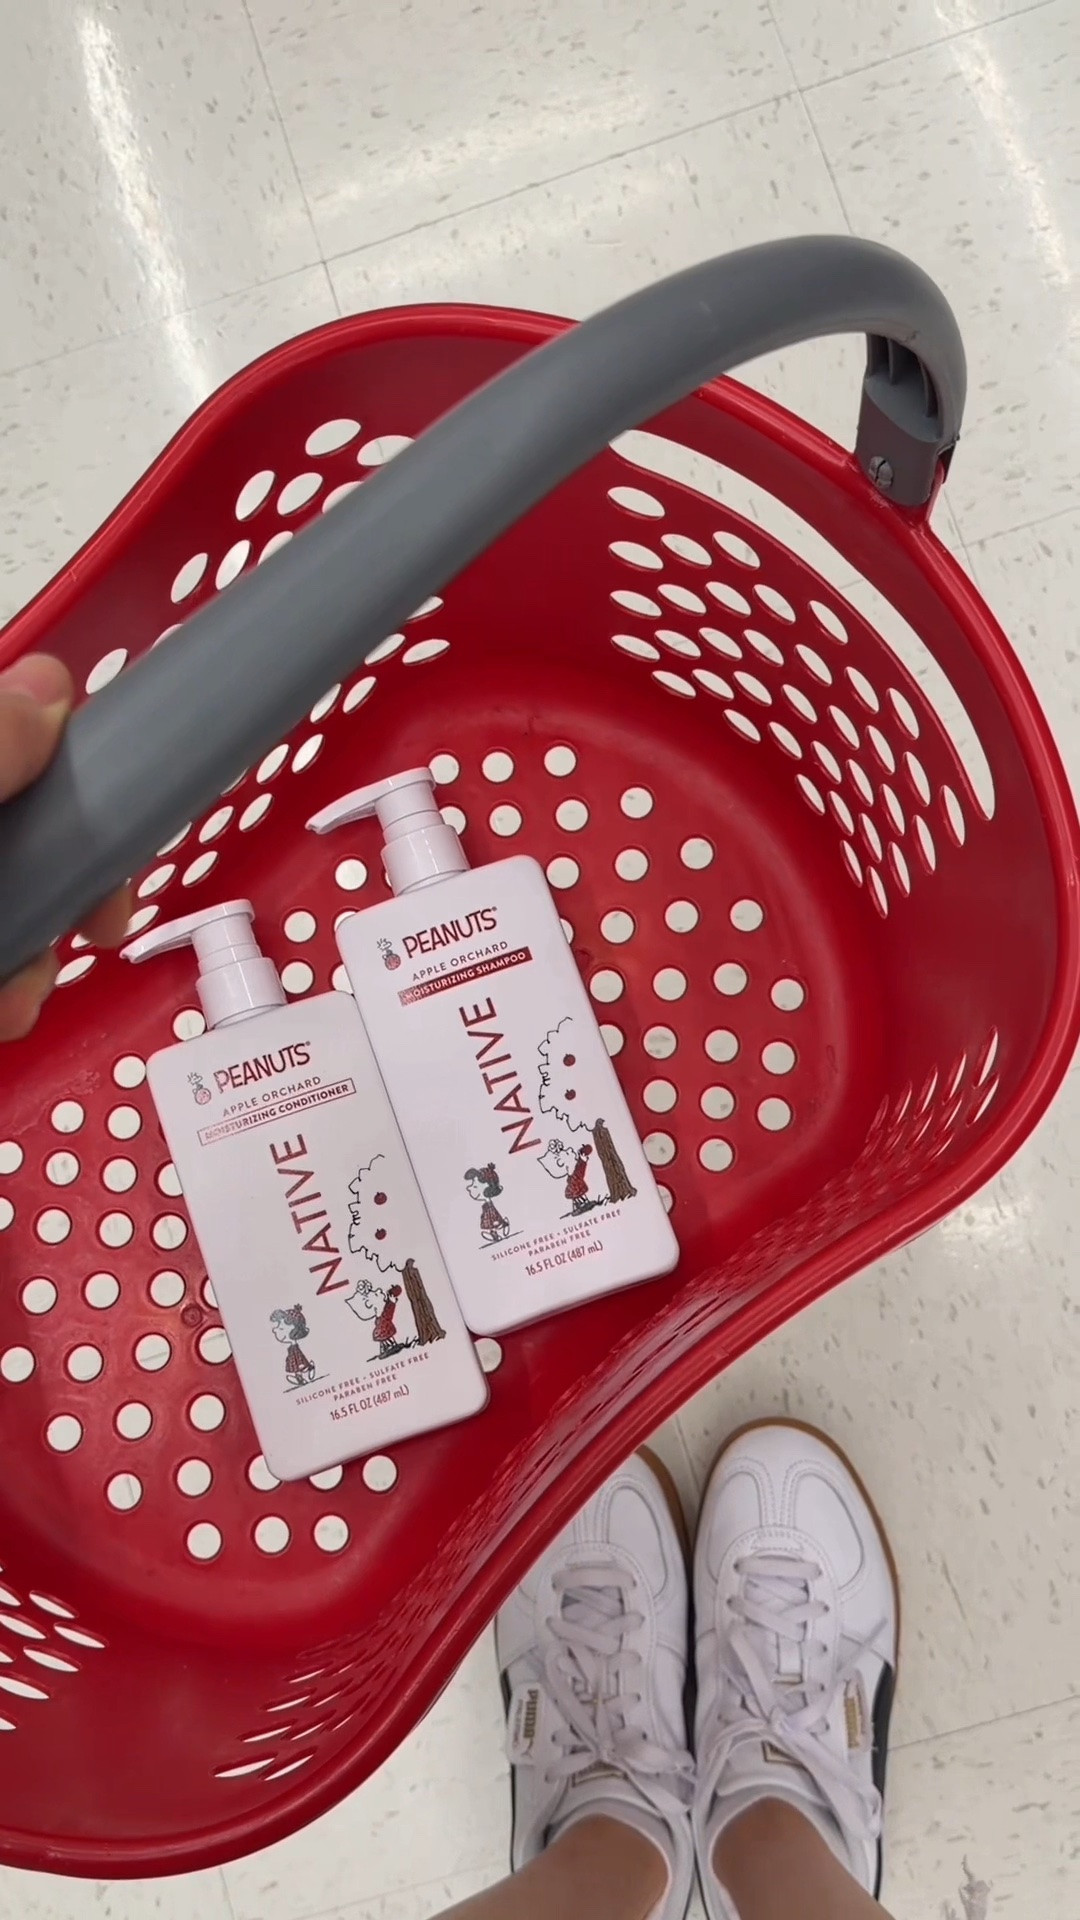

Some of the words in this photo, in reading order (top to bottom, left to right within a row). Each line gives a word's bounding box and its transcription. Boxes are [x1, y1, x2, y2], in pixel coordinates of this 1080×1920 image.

[404, 969, 475, 1000] MOISTURIZING
[475, 951, 526, 975] SHAMPOO
[412, 962, 447, 981] APPLE
[450, 941, 508, 967] ORCHARD
[222, 1097, 259, 1117] APPLE
[262, 1076, 321, 1102] ORCHARD
[459, 997, 541, 1154] NATIVE
[204, 1108, 277, 1140] MOISTURIZING
[278, 1084, 349, 1113] CONDITIONER
[269, 1133, 349, 1296] NATIVE
[492, 1241, 531, 1261] SILICONE
[534, 1232, 554, 1246] FREE
[563, 1217, 598, 1235] SULFATE
[525, 1258, 543, 1276] 16.5
[544, 1257, 555, 1271] FL
[556, 1253, 568, 1266] OZ
[568, 1245, 585, 1263] (487
[588, 1240, 604, 1256] mL)
[528, 1238, 567, 1257] PARABEN
[570, 1229, 591, 1242] FREE
[296, 1386, 336, 1405] SILICONE
[339, 1377, 360, 1390] FREE
[369, 1361, 405, 1379] SULFATE
[408, 1352, 429, 1365] FREE
[334, 1382, 373, 1401] PARABEN
[376, 1374, 397, 1387] FREE
[330, 1406, 348, 1421] 16.5
[348, 1403, 359, 1415] FL
[360, 1397, 373, 1411] OZ
[374, 1391, 391, 1407] (487
[394, 1384, 410, 1399] mL)
